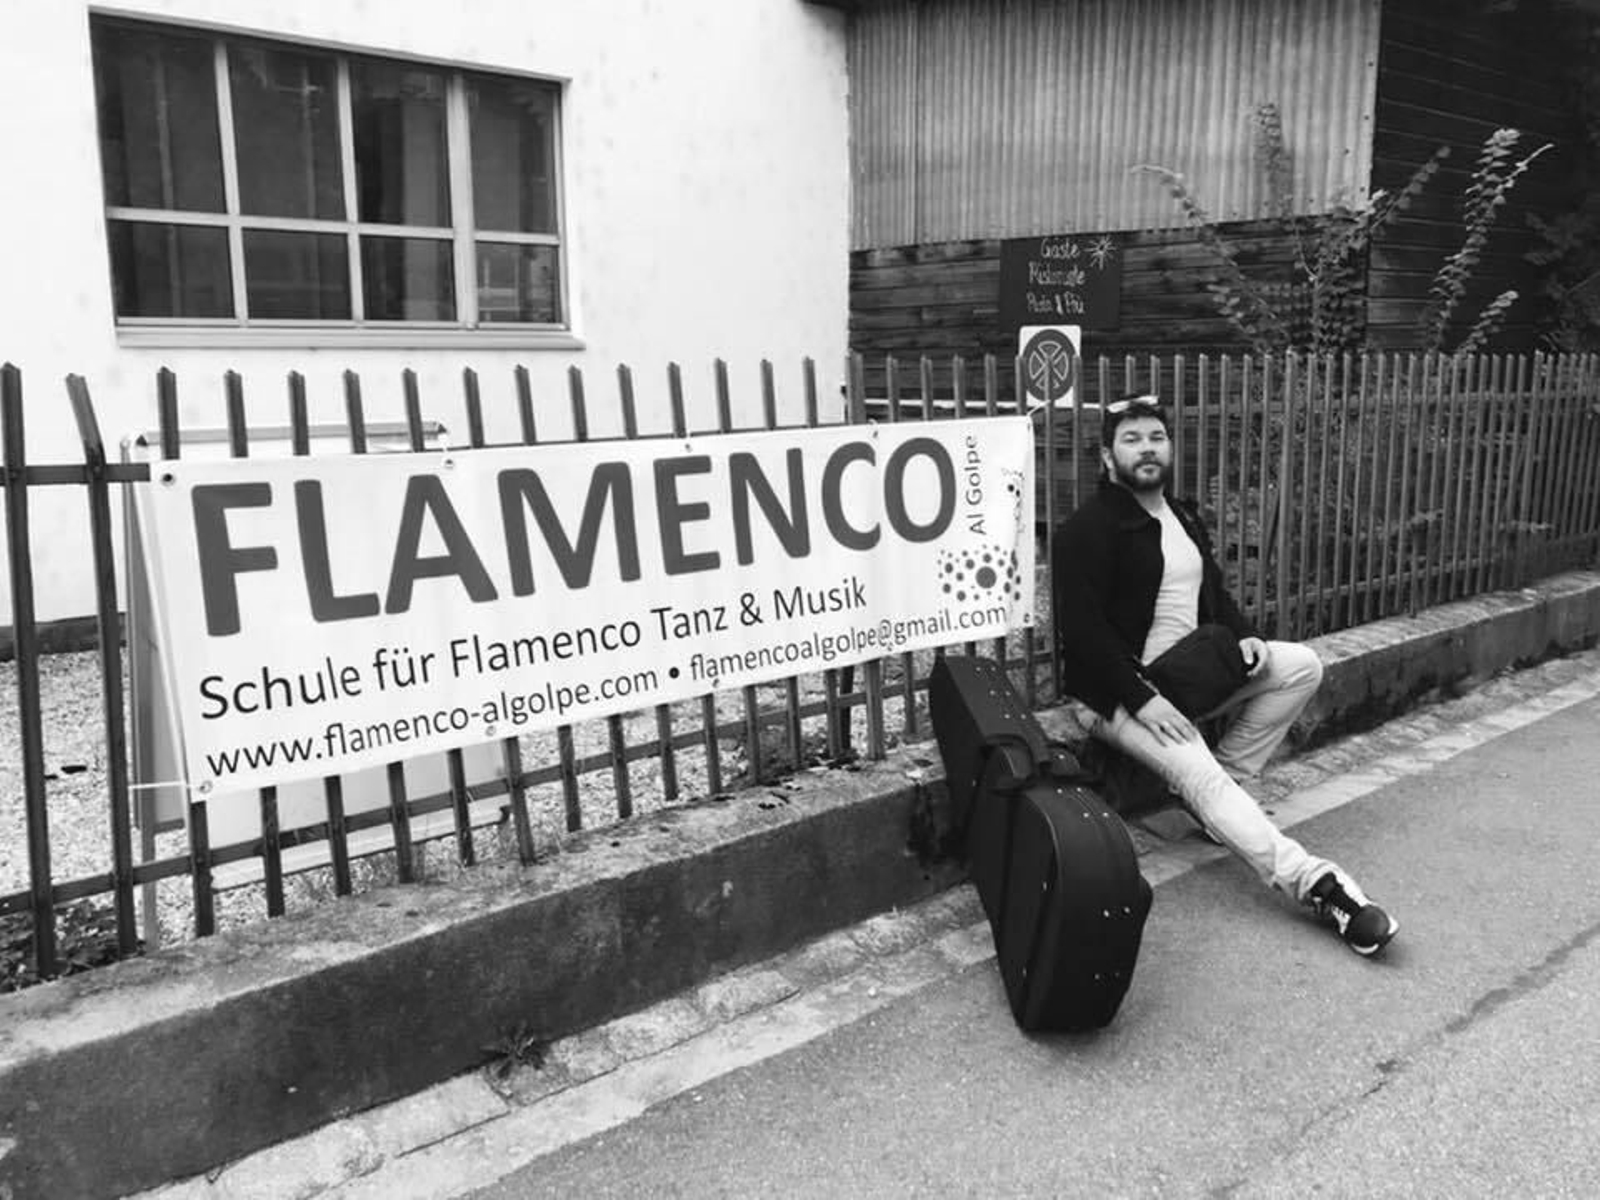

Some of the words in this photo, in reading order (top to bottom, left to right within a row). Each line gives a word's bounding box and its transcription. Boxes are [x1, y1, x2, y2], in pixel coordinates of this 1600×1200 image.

[190, 437, 957, 637] FLAMENCO
[964, 435, 983, 507] Golpe
[966, 514, 986, 536] Al
[200, 657, 362, 720] Schule
[372, 647, 437, 691] für
[449, 619, 642, 679] Flamenco
[650, 606, 729, 641] Tanz
[739, 592, 764, 627] &
[773, 576, 867, 621] Musik
[206, 670, 658, 777] www.flamenco-algolpe.com
[690, 606, 1006, 683] flamencoalgolpe@gmail.com
